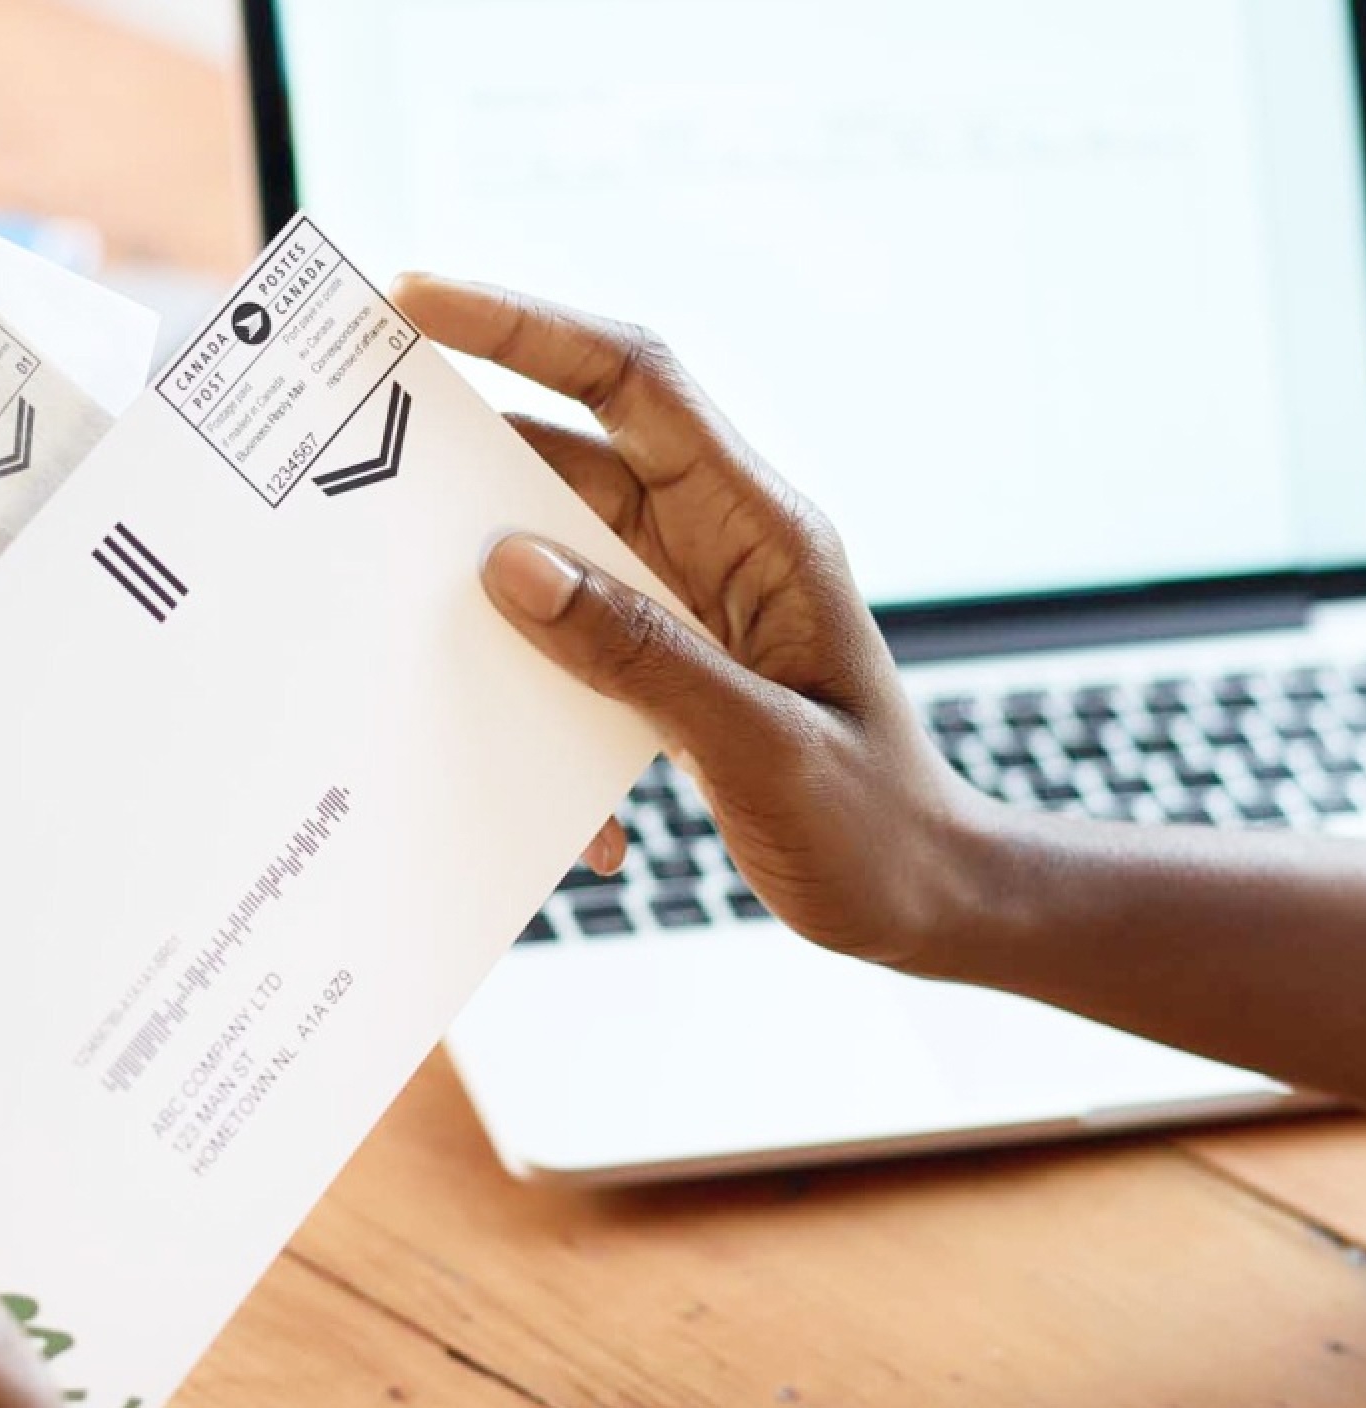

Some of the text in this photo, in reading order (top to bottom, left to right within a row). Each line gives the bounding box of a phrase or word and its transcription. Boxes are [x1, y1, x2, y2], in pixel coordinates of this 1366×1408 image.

[258, 243, 306, 296] POSTES
[274, 259, 326, 315] CANADA
[176, 333, 230, 391] CANADA
[388, 329, 408, 351] 01
[192, 371, 226, 409] POST
[266, 431, 318, 495] 1234567
[152, 972, 283, 1136] ABC COMPANY LTD
[191, 969, 354, 1176] HOMETOWN NL A1A 9Z9
[172, 1048, 254, 1153] 123 MAIN ST
